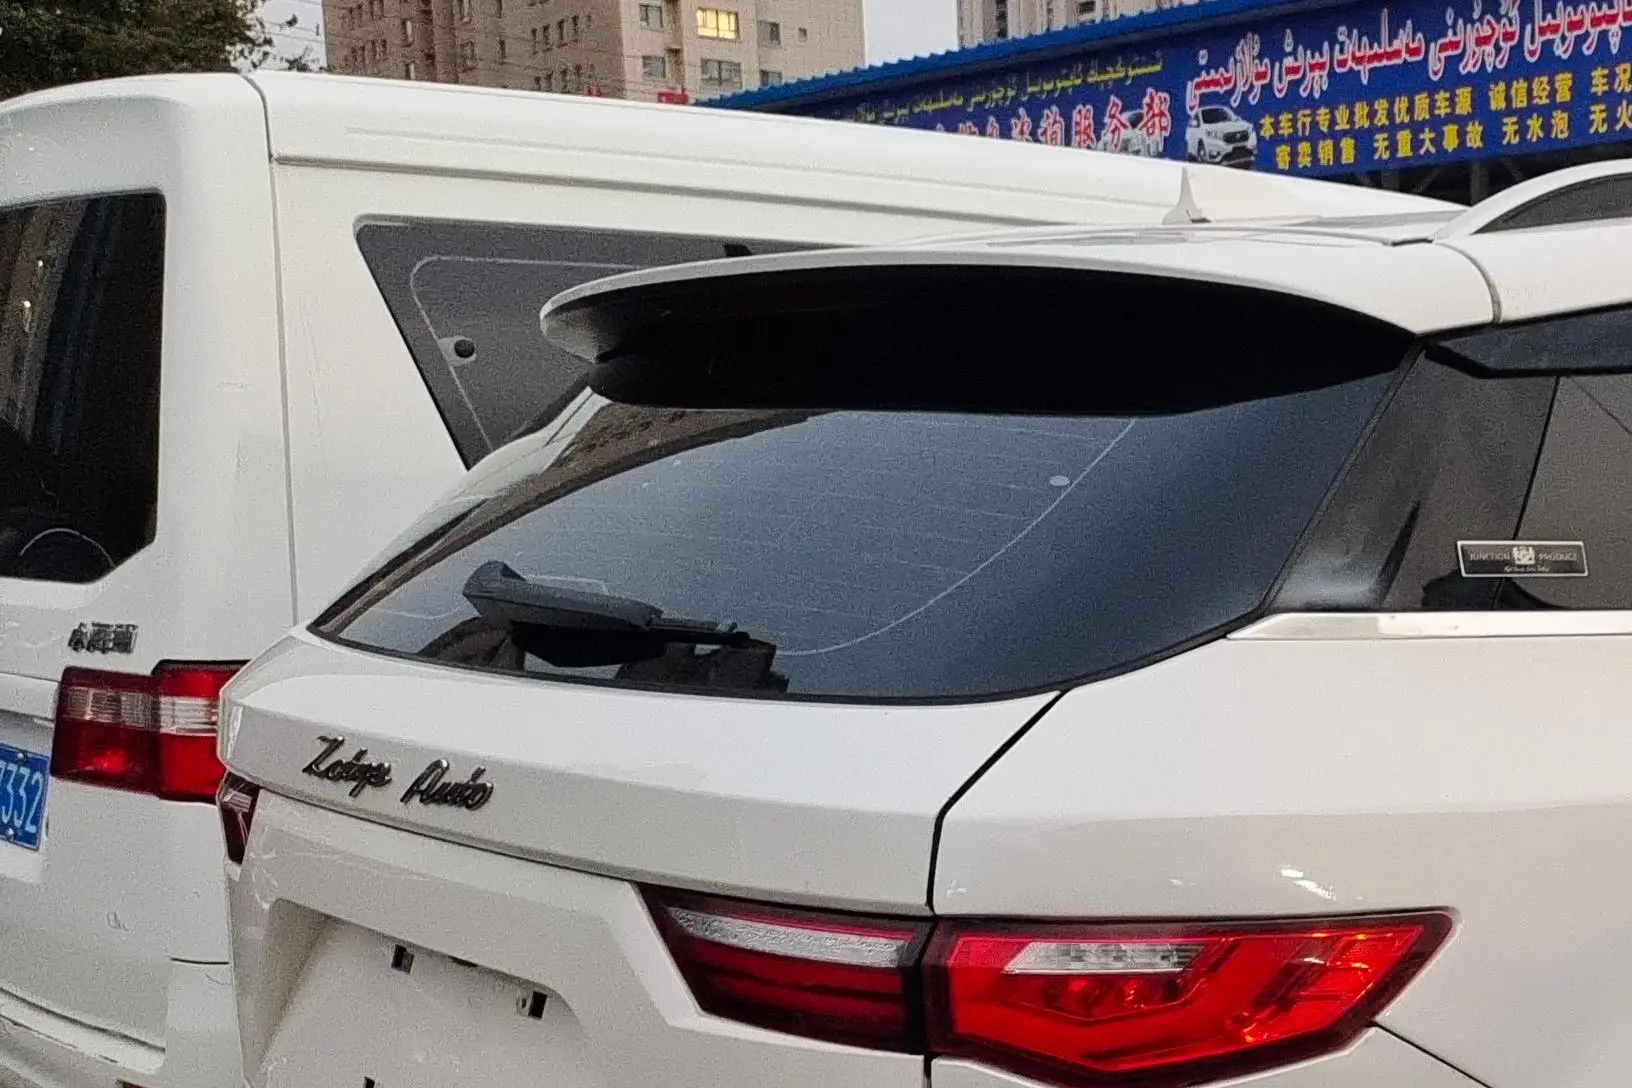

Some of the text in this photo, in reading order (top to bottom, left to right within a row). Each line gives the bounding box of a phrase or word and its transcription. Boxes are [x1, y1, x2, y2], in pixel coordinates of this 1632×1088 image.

[1259, 86, 1473, 139] 本车行专业批发优质车源
[1488, 71, 1573, 111] 诚信经营
[1275, 136, 1356, 170] 寄卖销售
[1373, 120, 1484, 160] 无重大事故
[1502, 108, 1570, 145] 无水泡
[400, 758, 495, 811] Auto
